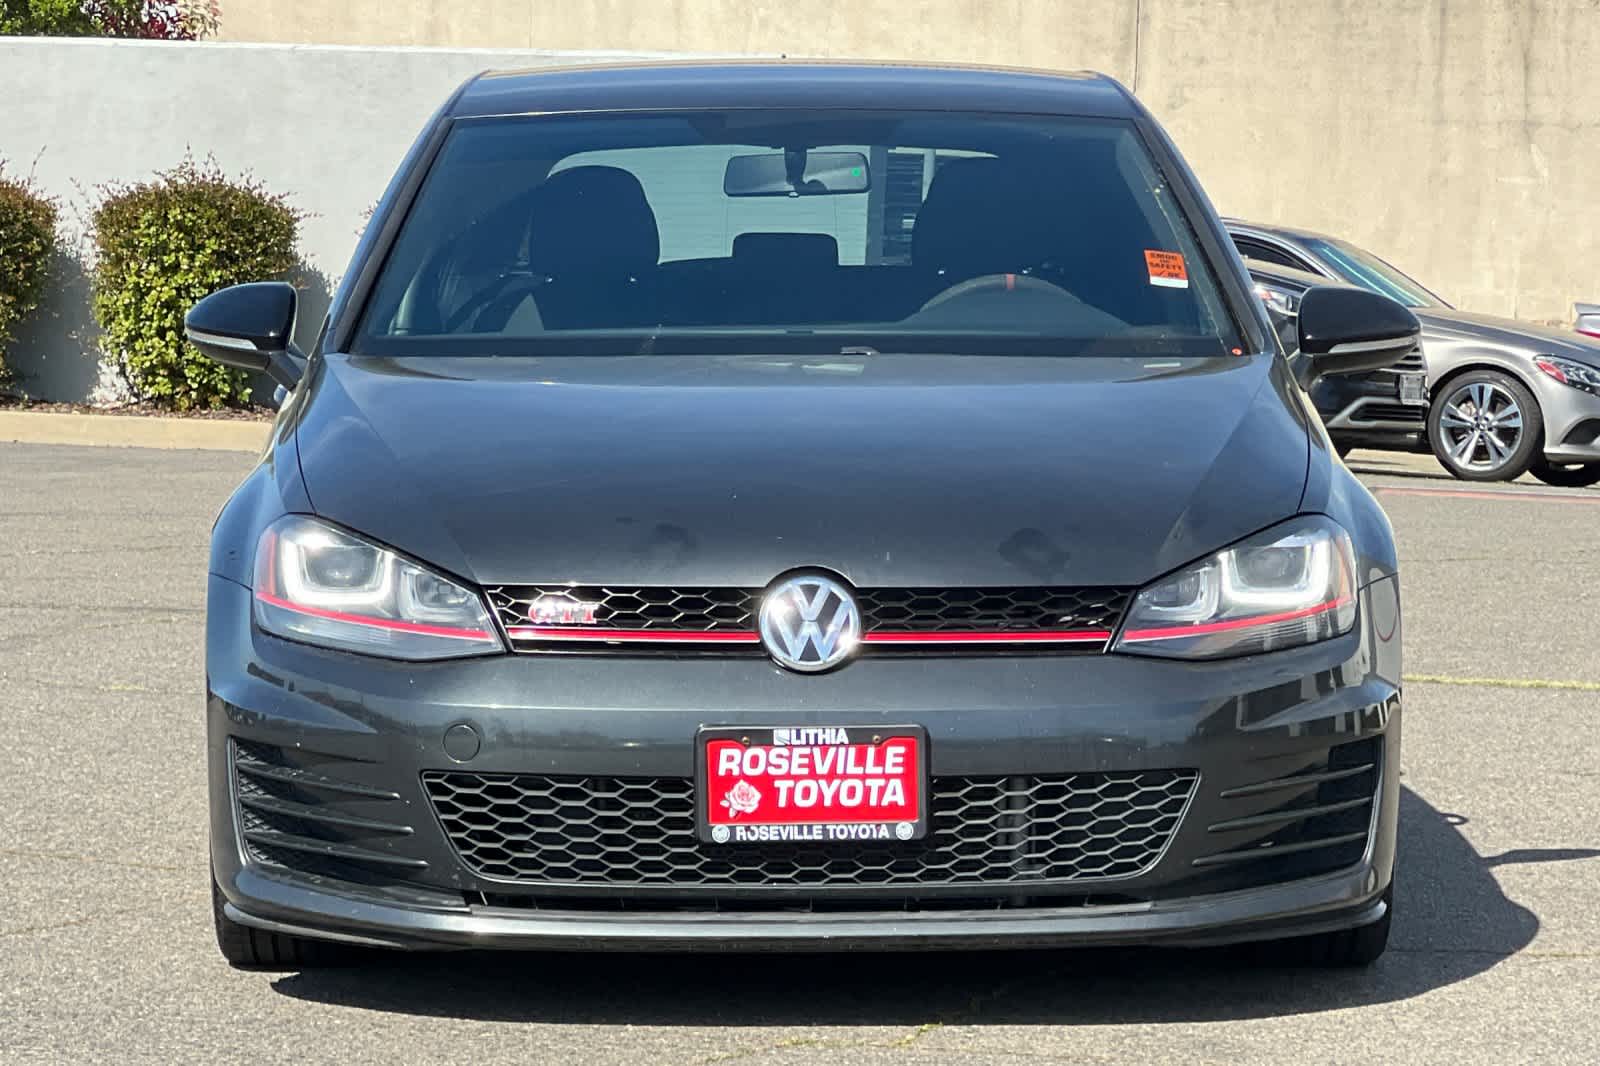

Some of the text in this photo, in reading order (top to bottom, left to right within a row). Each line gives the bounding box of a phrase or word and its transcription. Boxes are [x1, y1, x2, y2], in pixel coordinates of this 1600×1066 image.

[766, 578, 854, 664] VW
[790, 728, 849, 745] LITHIA
[718, 746, 906, 777] ROSEVILLE
[774, 778, 906, 808] TOYOTA
[736, 823, 890, 841] ROSEVILLE TOYOTA
